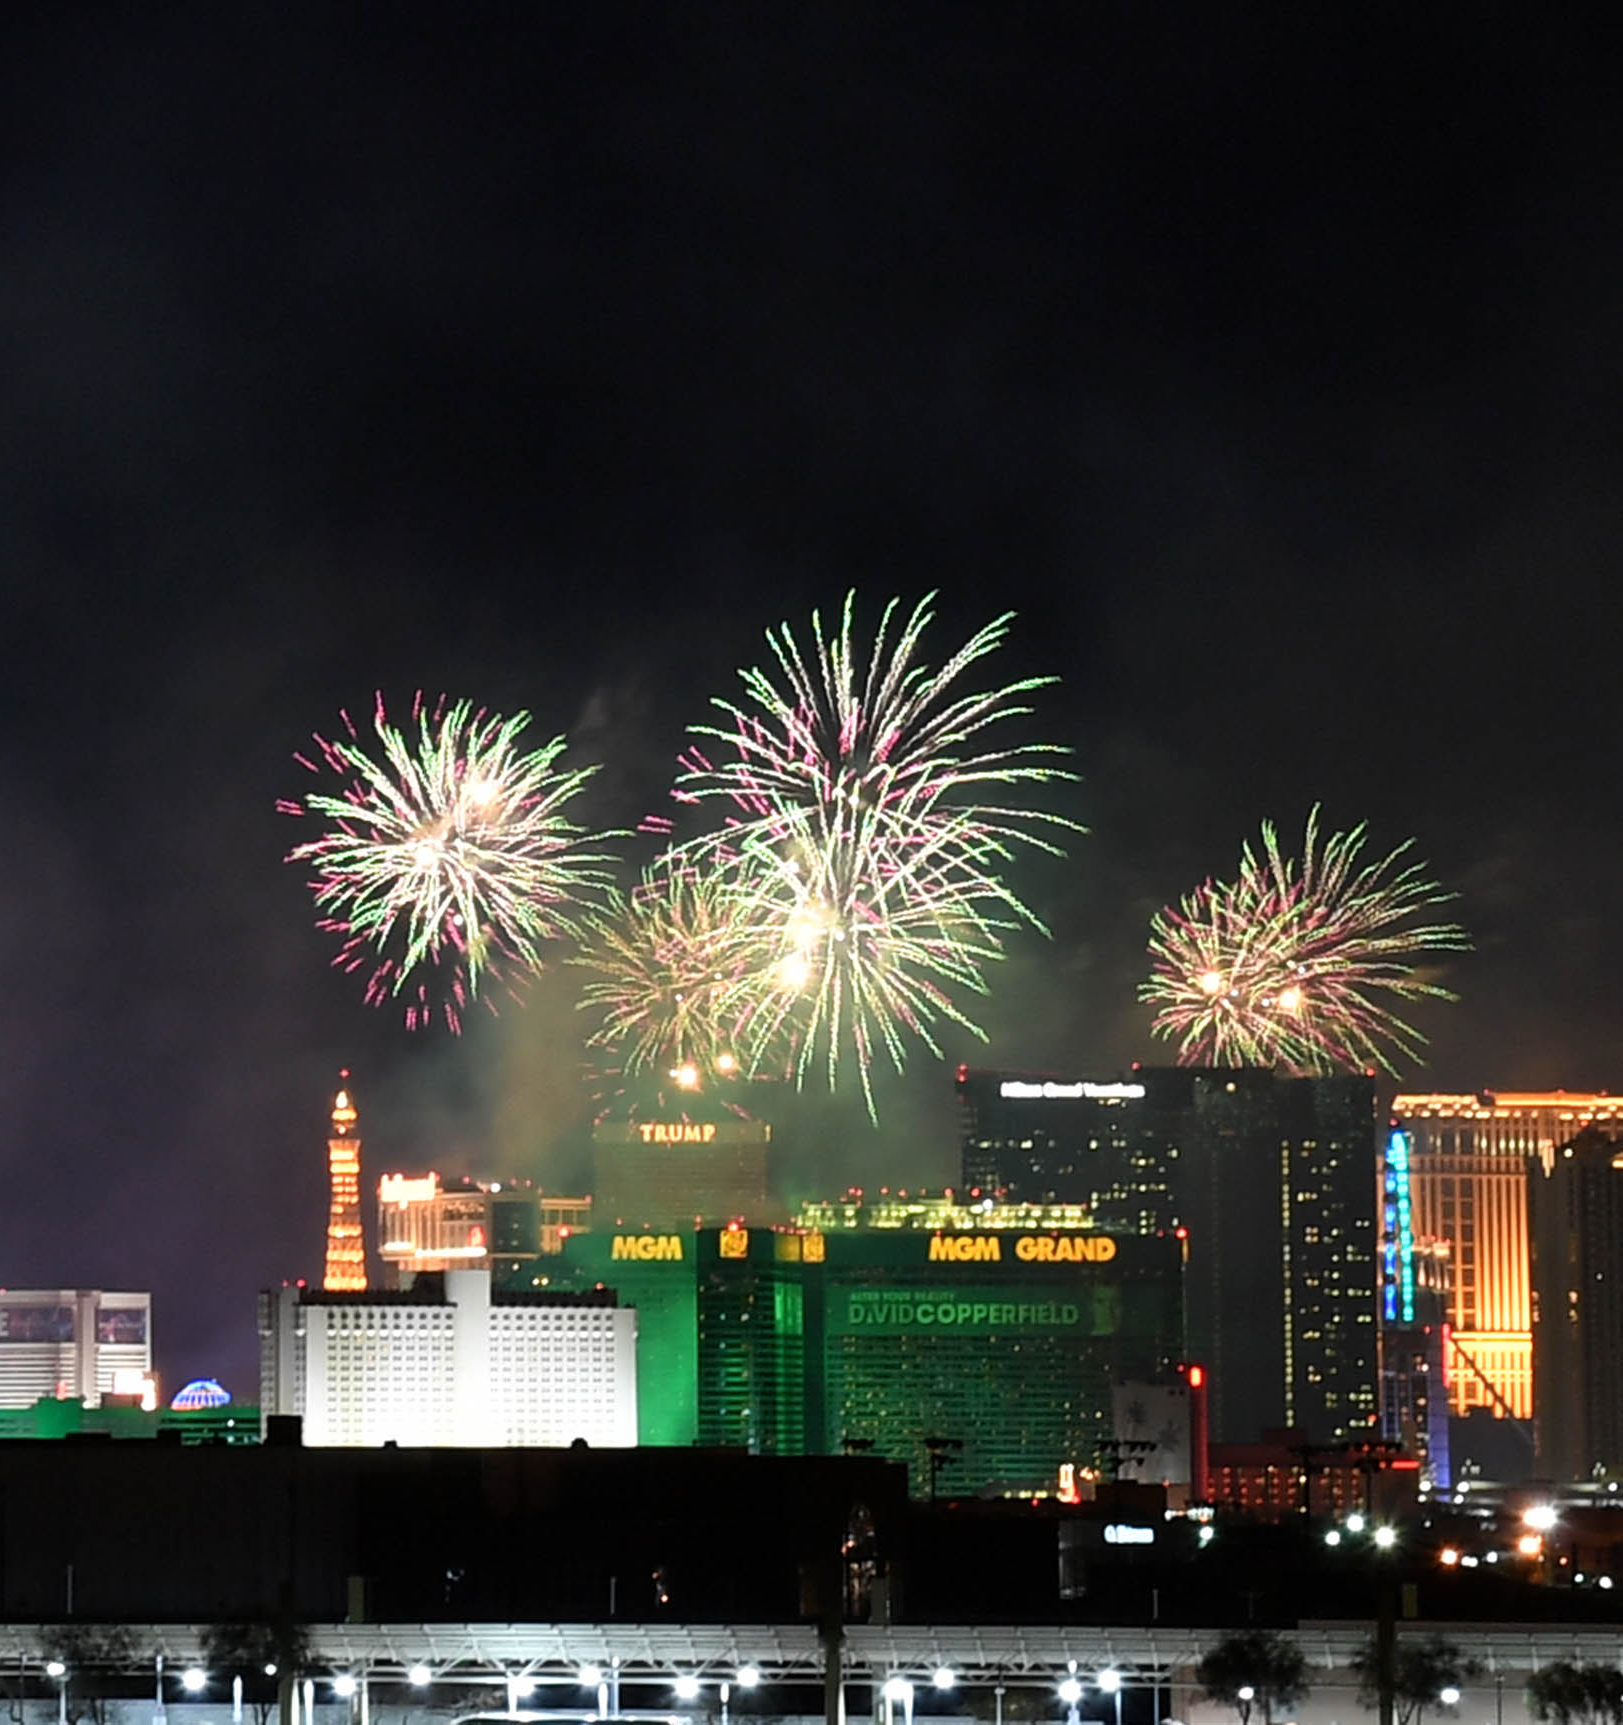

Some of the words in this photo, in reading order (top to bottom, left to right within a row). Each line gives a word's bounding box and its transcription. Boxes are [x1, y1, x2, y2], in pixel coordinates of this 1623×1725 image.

[640, 1123, 716, 1143] TRUMP
[611, 1235, 683, 1261] MGM
[929, 1237, 1002, 1261] MGM
[1015, 1237, 1116, 1261] GRAND
